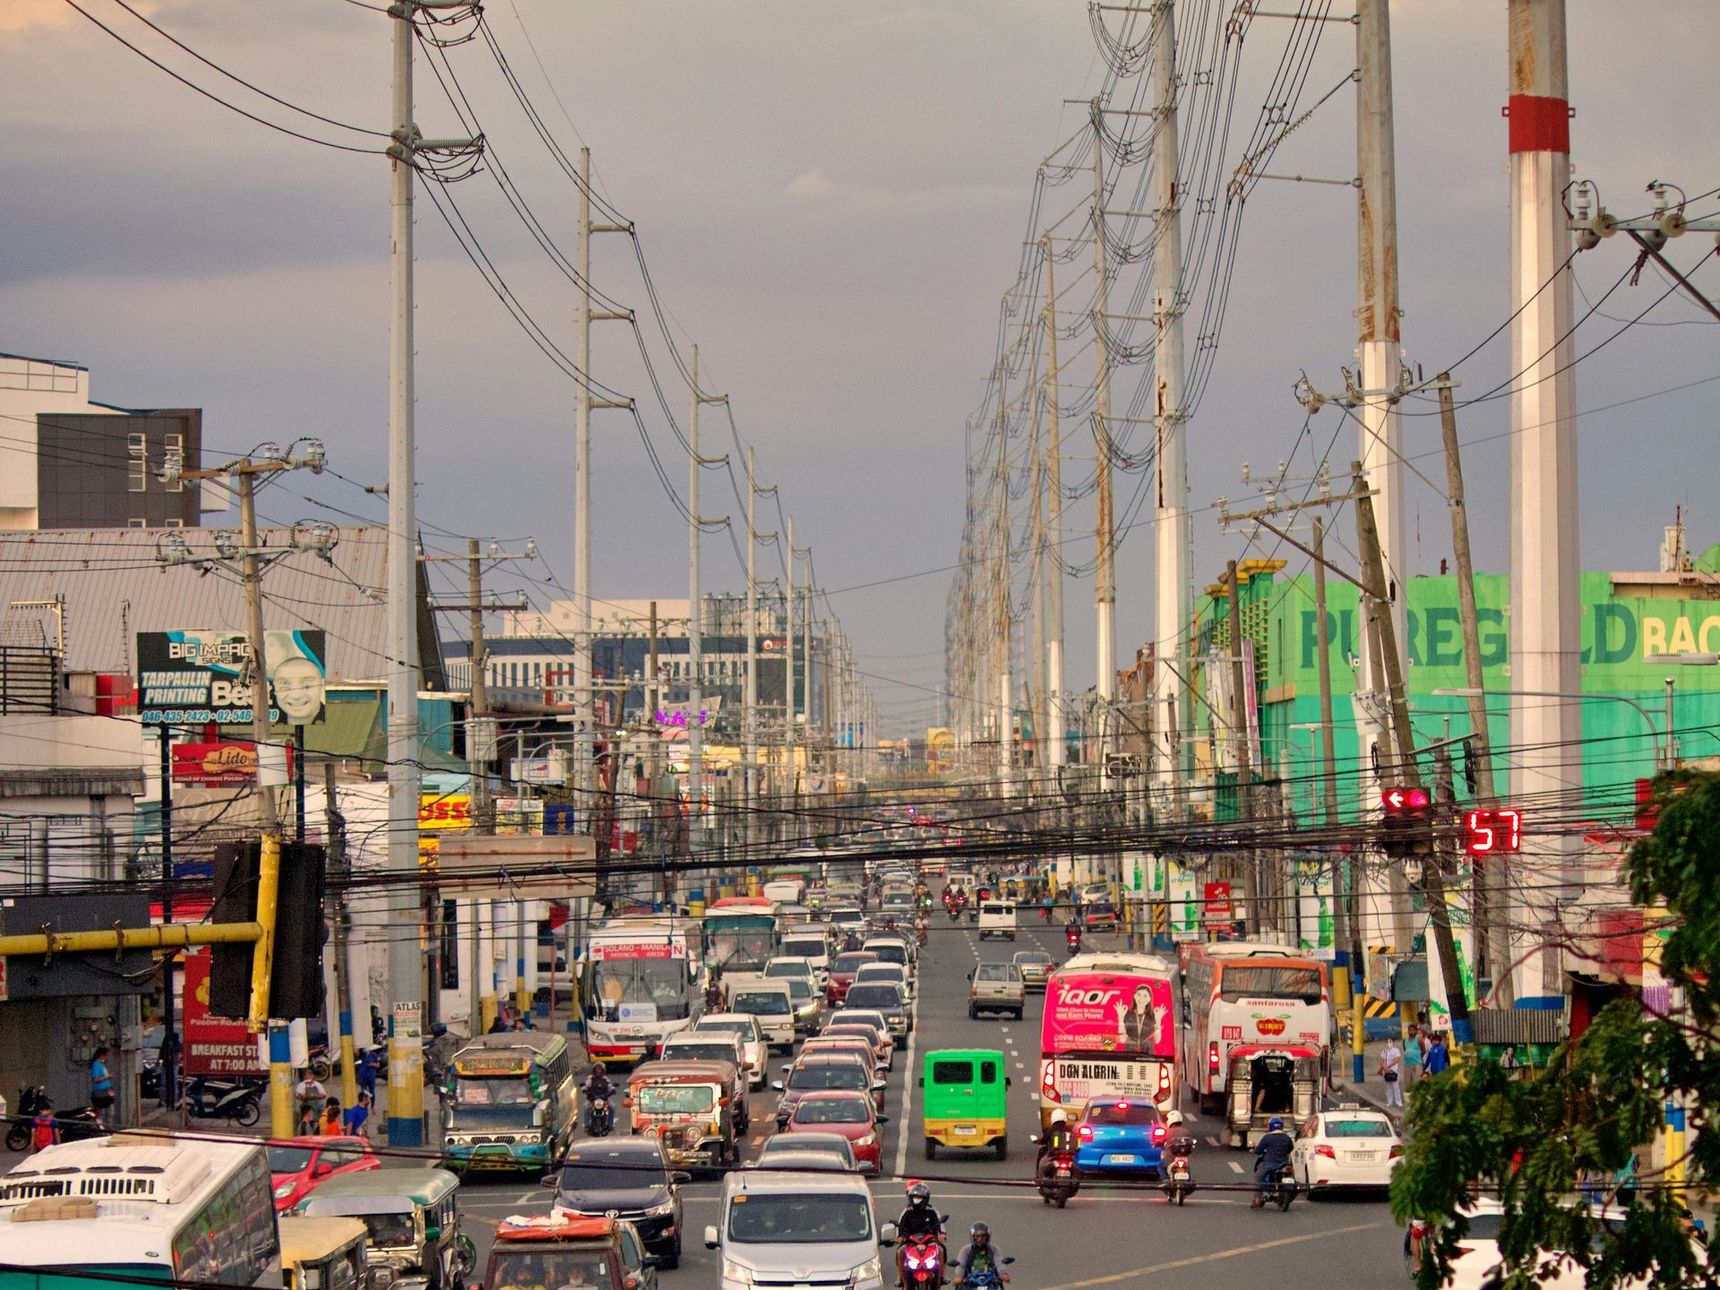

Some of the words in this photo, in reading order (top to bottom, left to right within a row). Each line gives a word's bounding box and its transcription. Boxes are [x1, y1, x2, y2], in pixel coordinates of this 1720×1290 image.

[169, 643, 196, 659] BIG
[200, 643, 252, 658] IMPAC
[142, 671, 213, 688] TARPAULIN
[144, 688, 207, 705] PRINTING
[212, 681, 273, 706] Bet
[142, 710, 210, 722] 046-435-2423
[218, 752, 248, 765] Lido
[1471, 810, 1519, 850] 57
[191, 1044, 244, 1056] BREAKFAST
[245, 1045, 258, 1056] ST
[210, 1059, 222, 1070] AT
[224, 1059, 245, 1070] 7:00
